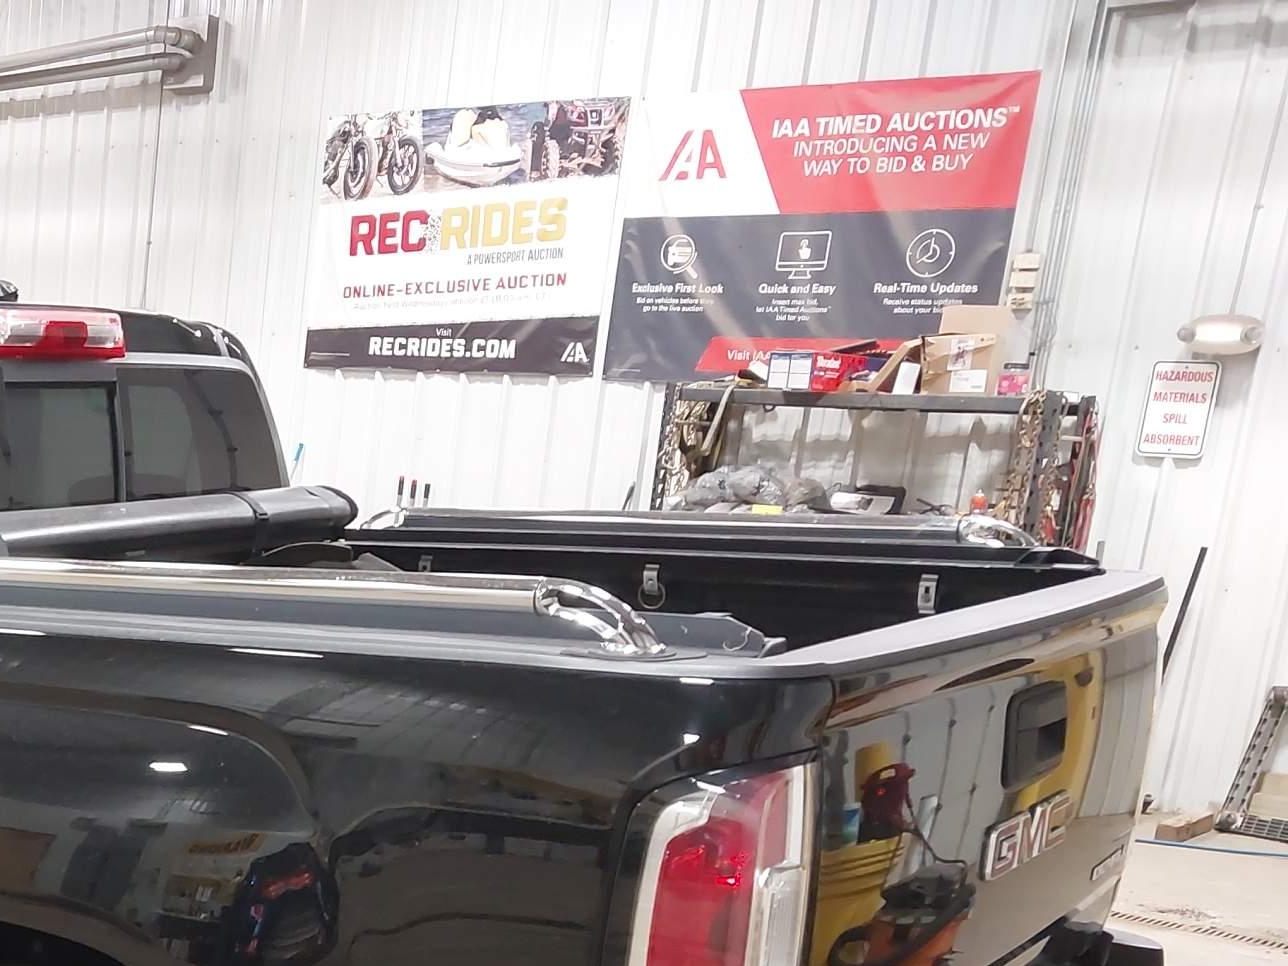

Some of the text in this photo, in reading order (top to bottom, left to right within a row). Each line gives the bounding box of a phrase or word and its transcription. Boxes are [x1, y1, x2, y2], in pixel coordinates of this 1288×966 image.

[772, 119, 810, 138] IAA
[816, 114, 881, 137] TIMED
[793, 132, 990, 157] INTRODUCING A NEW
[803, 153, 973, 176] WAY TO BID & BUY
[349, 196, 569, 256] REC RIDES
[467, 247, 564, 265] A POWERSPORT AUCTION
[343, 272, 567, 299] ONLINE-EXCLUSIVE AUCTION
[632, 283, 724, 294] Exclusive First Look
[758, 283, 836, 295] Quick and Easy
[873, 283, 978, 294] Real-Time Updates
[436, 328, 452, 337] Visit
[368, 337, 517, 359] RECRIDES.COM
[727, 350, 750, 360] Visit
[1155, 370, 1213, 383] HAZARDOUS
[1153, 392, 1208, 404] MATERIALS
[1163, 413, 1188, 424] SPILL
[1143, 433, 1200, 446] ABSORBENT
[981, 790, 1071, 881] GMC
